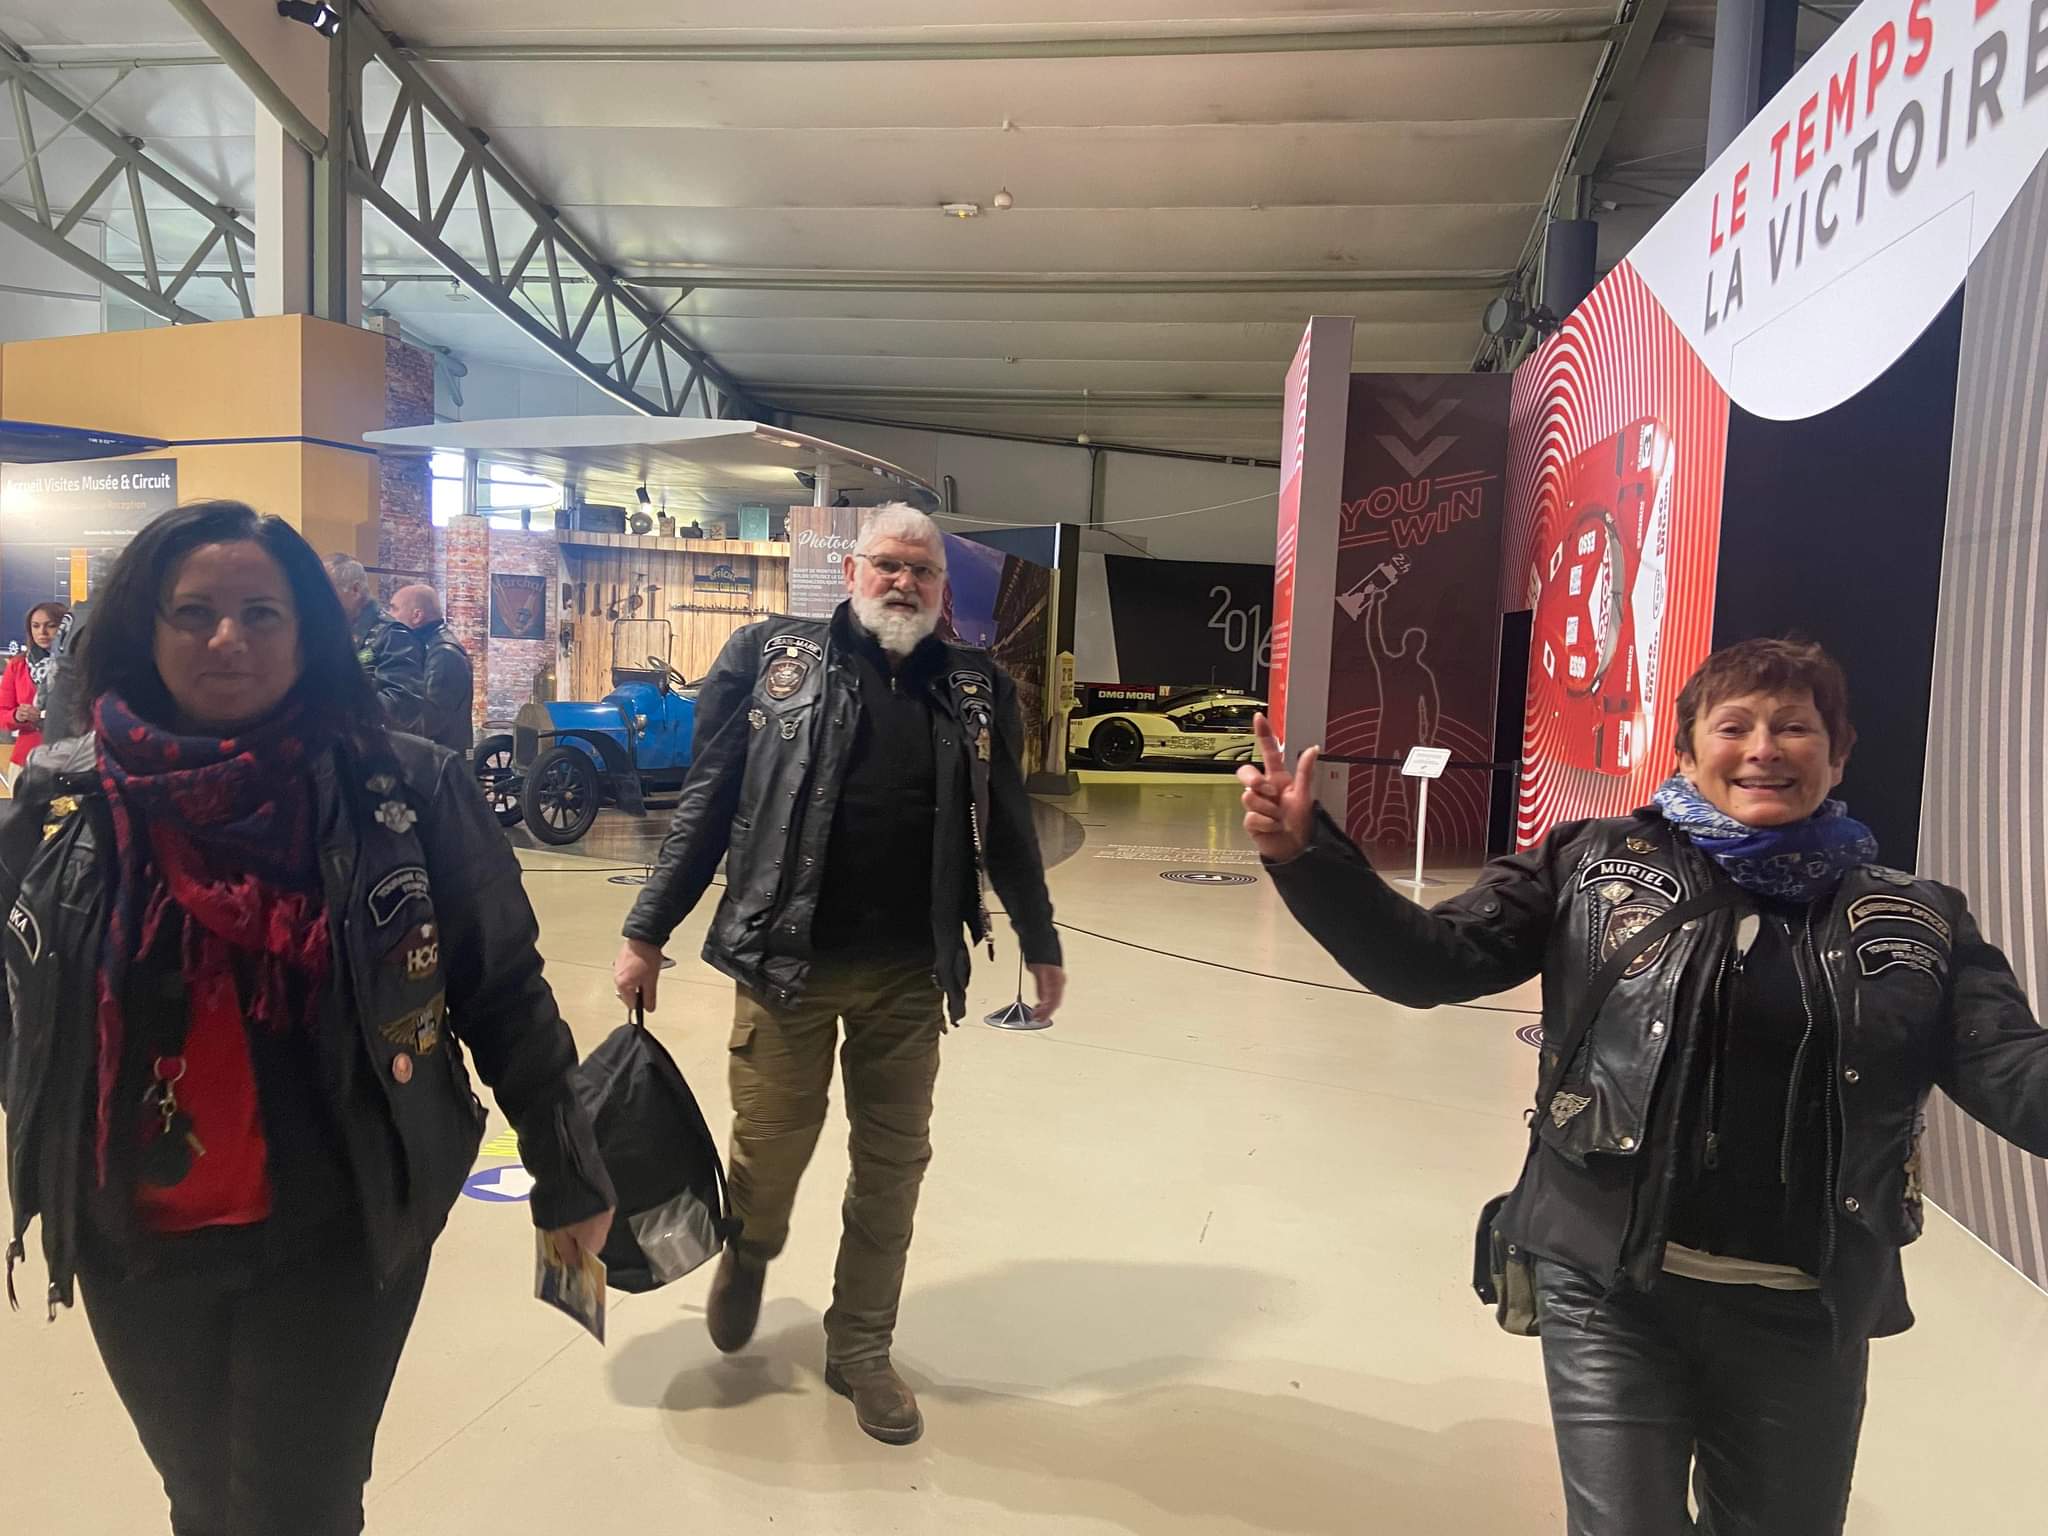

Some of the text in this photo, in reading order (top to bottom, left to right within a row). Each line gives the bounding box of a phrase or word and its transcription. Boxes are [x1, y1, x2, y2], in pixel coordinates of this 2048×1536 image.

[1710, 0, 1932, 257] LE TEMPS
[1704, 0, 2048, 336] LA VICTOIRE
[6, 472, 171, 493] Accueil Visites Musée & Circuit
[1340, 480, 1430, 532] YOU
[1392, 488, 1482, 548] WIN
[1098, 690, 1155, 700] DMG MORI
[1600, 863, 1665, 887] MURIEL
